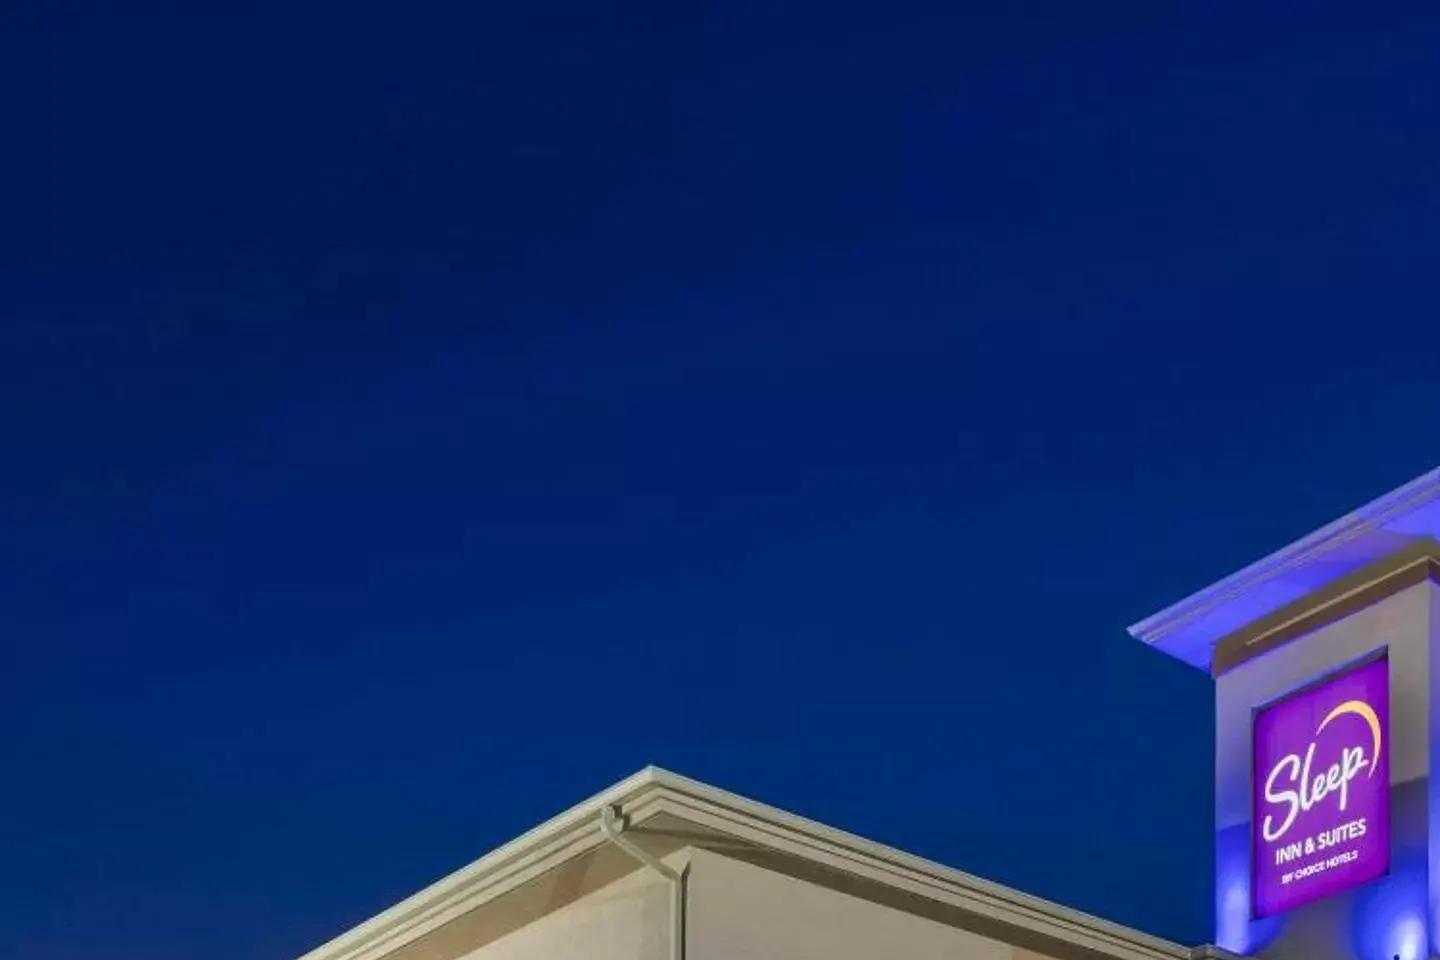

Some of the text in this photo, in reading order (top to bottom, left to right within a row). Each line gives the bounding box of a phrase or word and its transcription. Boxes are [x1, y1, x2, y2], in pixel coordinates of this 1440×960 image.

[1263, 742, 1369, 842] Sleep
[1276, 818, 1366, 865] INN & SUITES
[1282, 850, 1358, 884] BY CHOICE HOTELS
